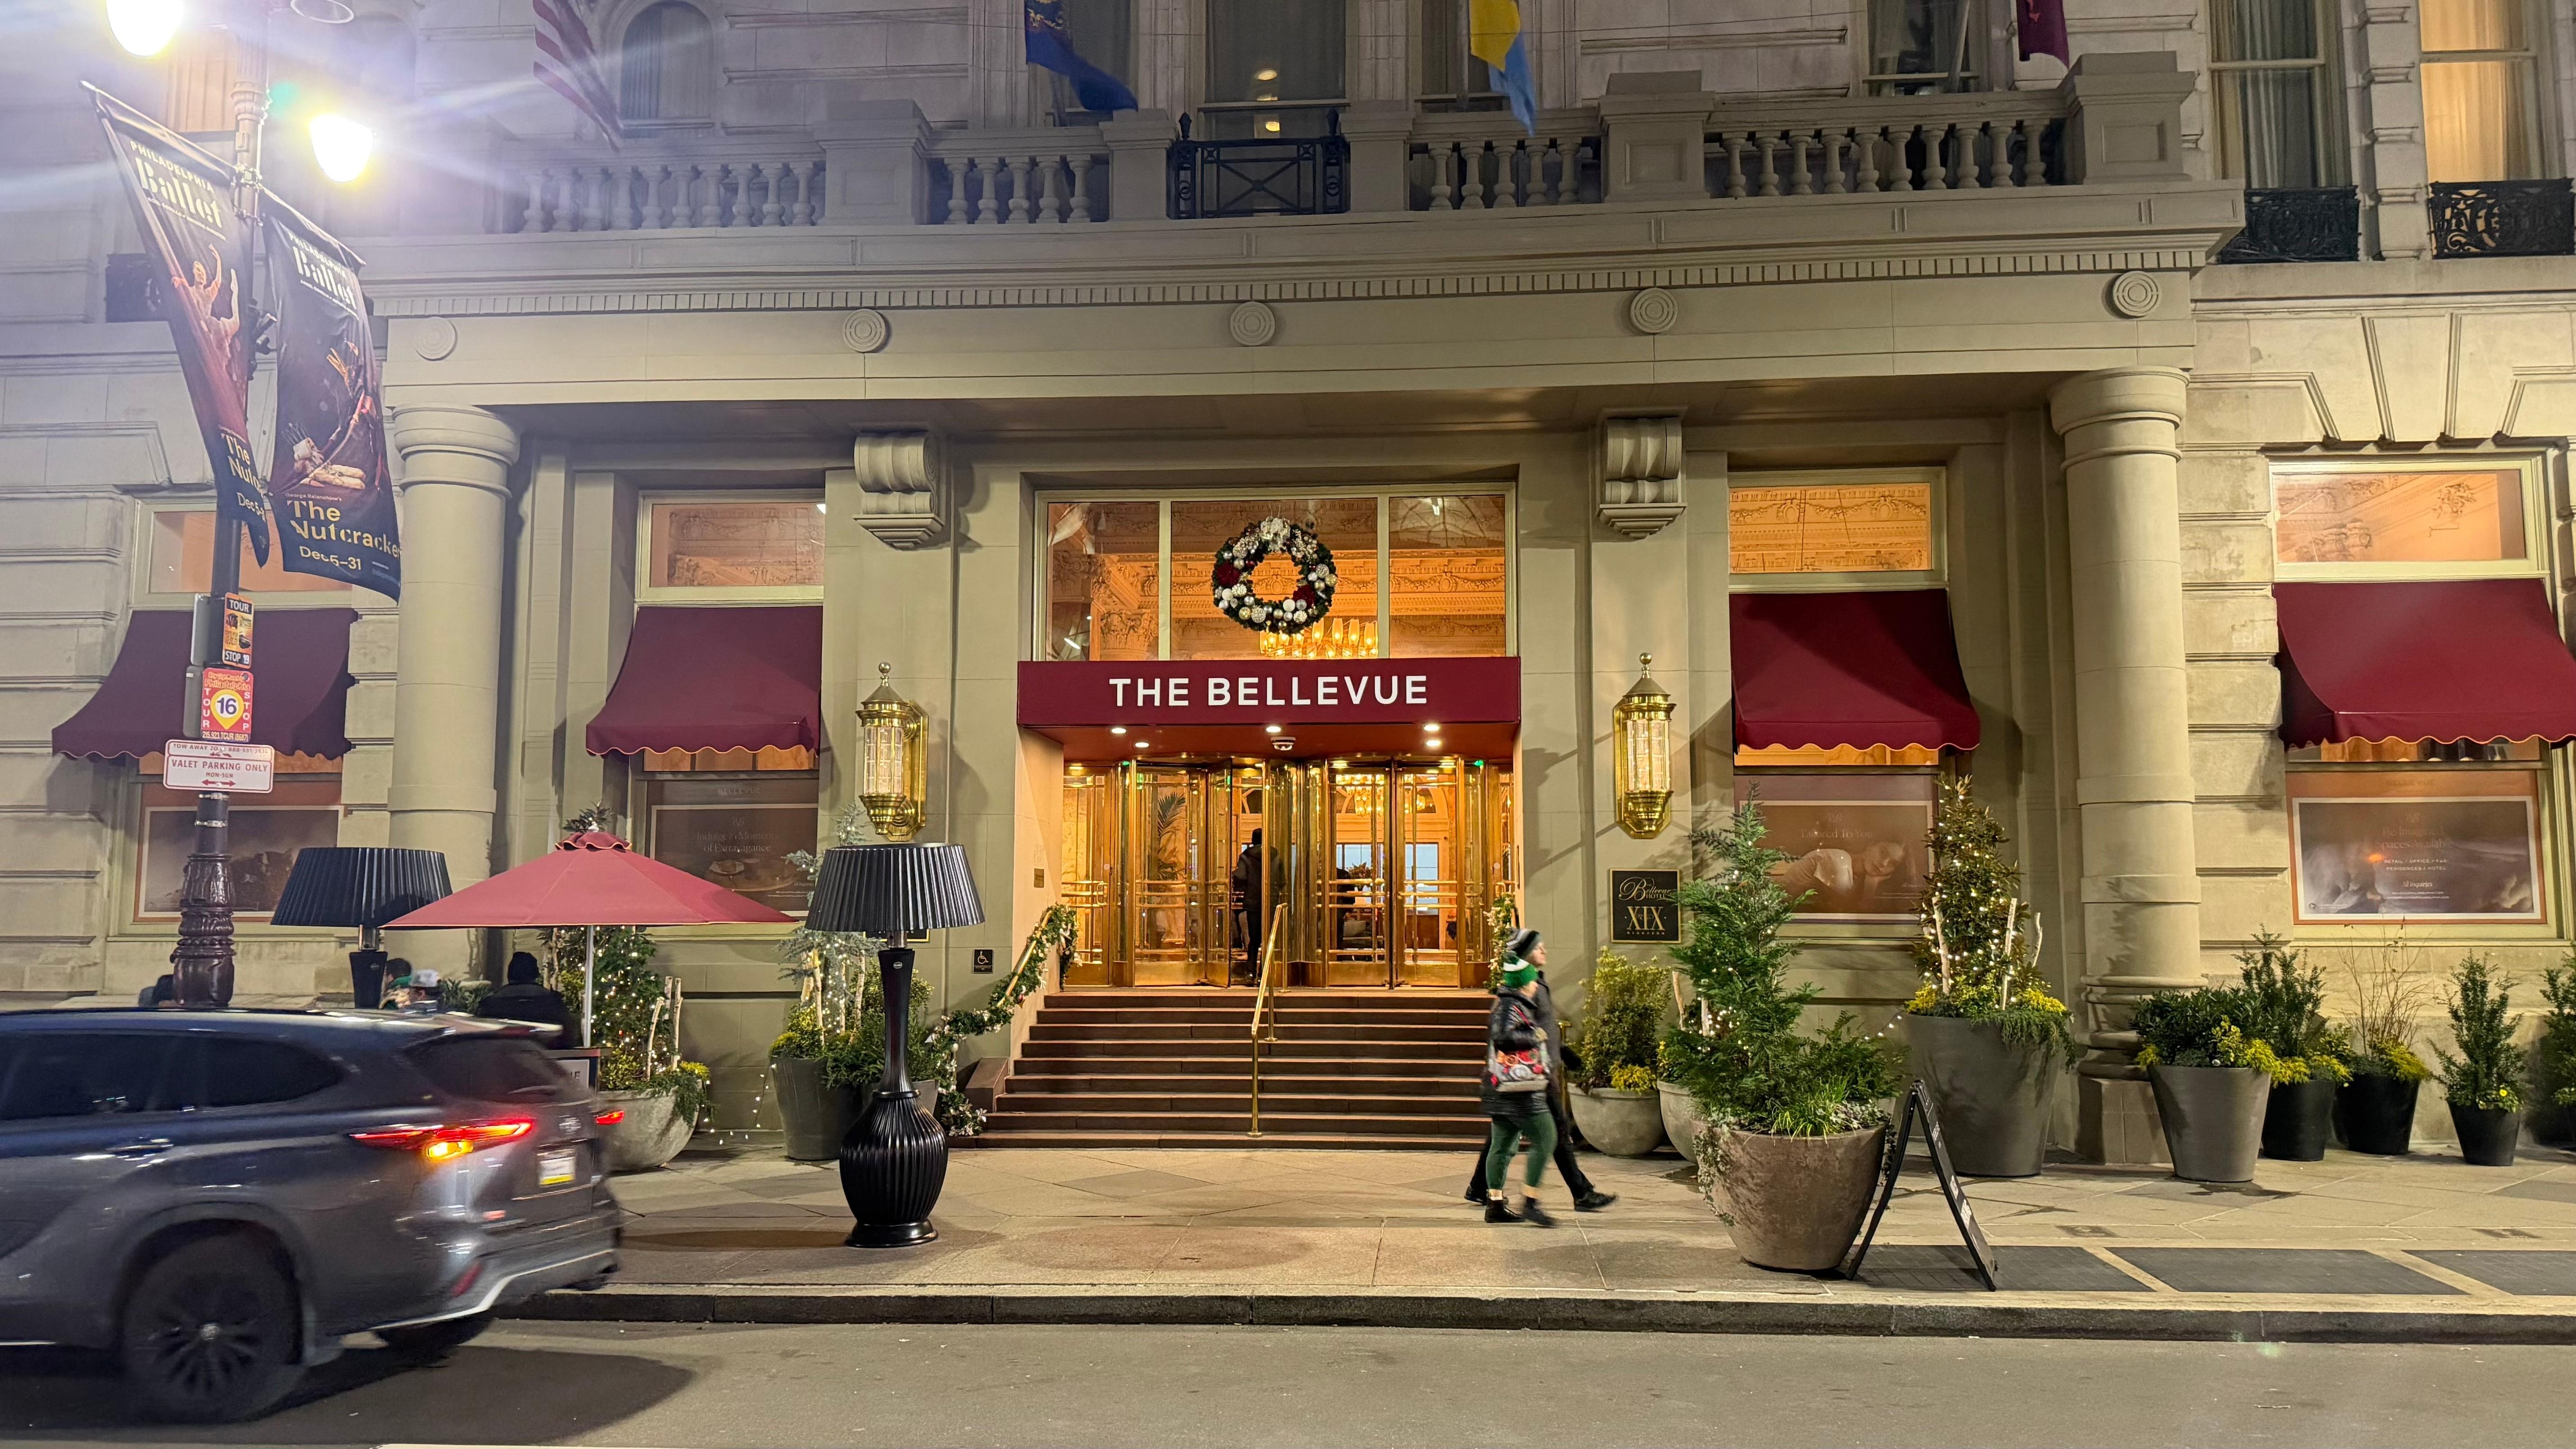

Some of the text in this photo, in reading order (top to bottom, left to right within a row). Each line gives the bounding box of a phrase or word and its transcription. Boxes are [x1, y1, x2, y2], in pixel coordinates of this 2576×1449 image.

[130, 140, 214, 194] PHILADELPHIA
[135, 157, 222, 228] Ballet
[289, 232, 347, 280] PHILADELPHIA
[293, 246, 357, 309] Ballet
[221, 433, 250, 465] The
[286, 500, 341, 522] The
[229, 600, 249, 613] TOUR
[225, 651, 241, 662] STOP
[1109, 675, 1427, 707] THE BELLEVUE
[202, 688, 211, 728] TOUR
[216, 697, 237, 715] 16
[242, 691, 251, 731] STOP
[172, 759, 268, 772] VALET PARKING ONLY
[697, 831, 727, 843] Indulge
[738, 830, 779, 841] Moments
[1799, 828, 1838, 838] Tailored
[1855, 829, 1873, 838] You
[714, 843, 772, 854] Extravagance
[1618, 876, 1673, 901] Bellevue
[1626, 906, 1665, 931] XIX
